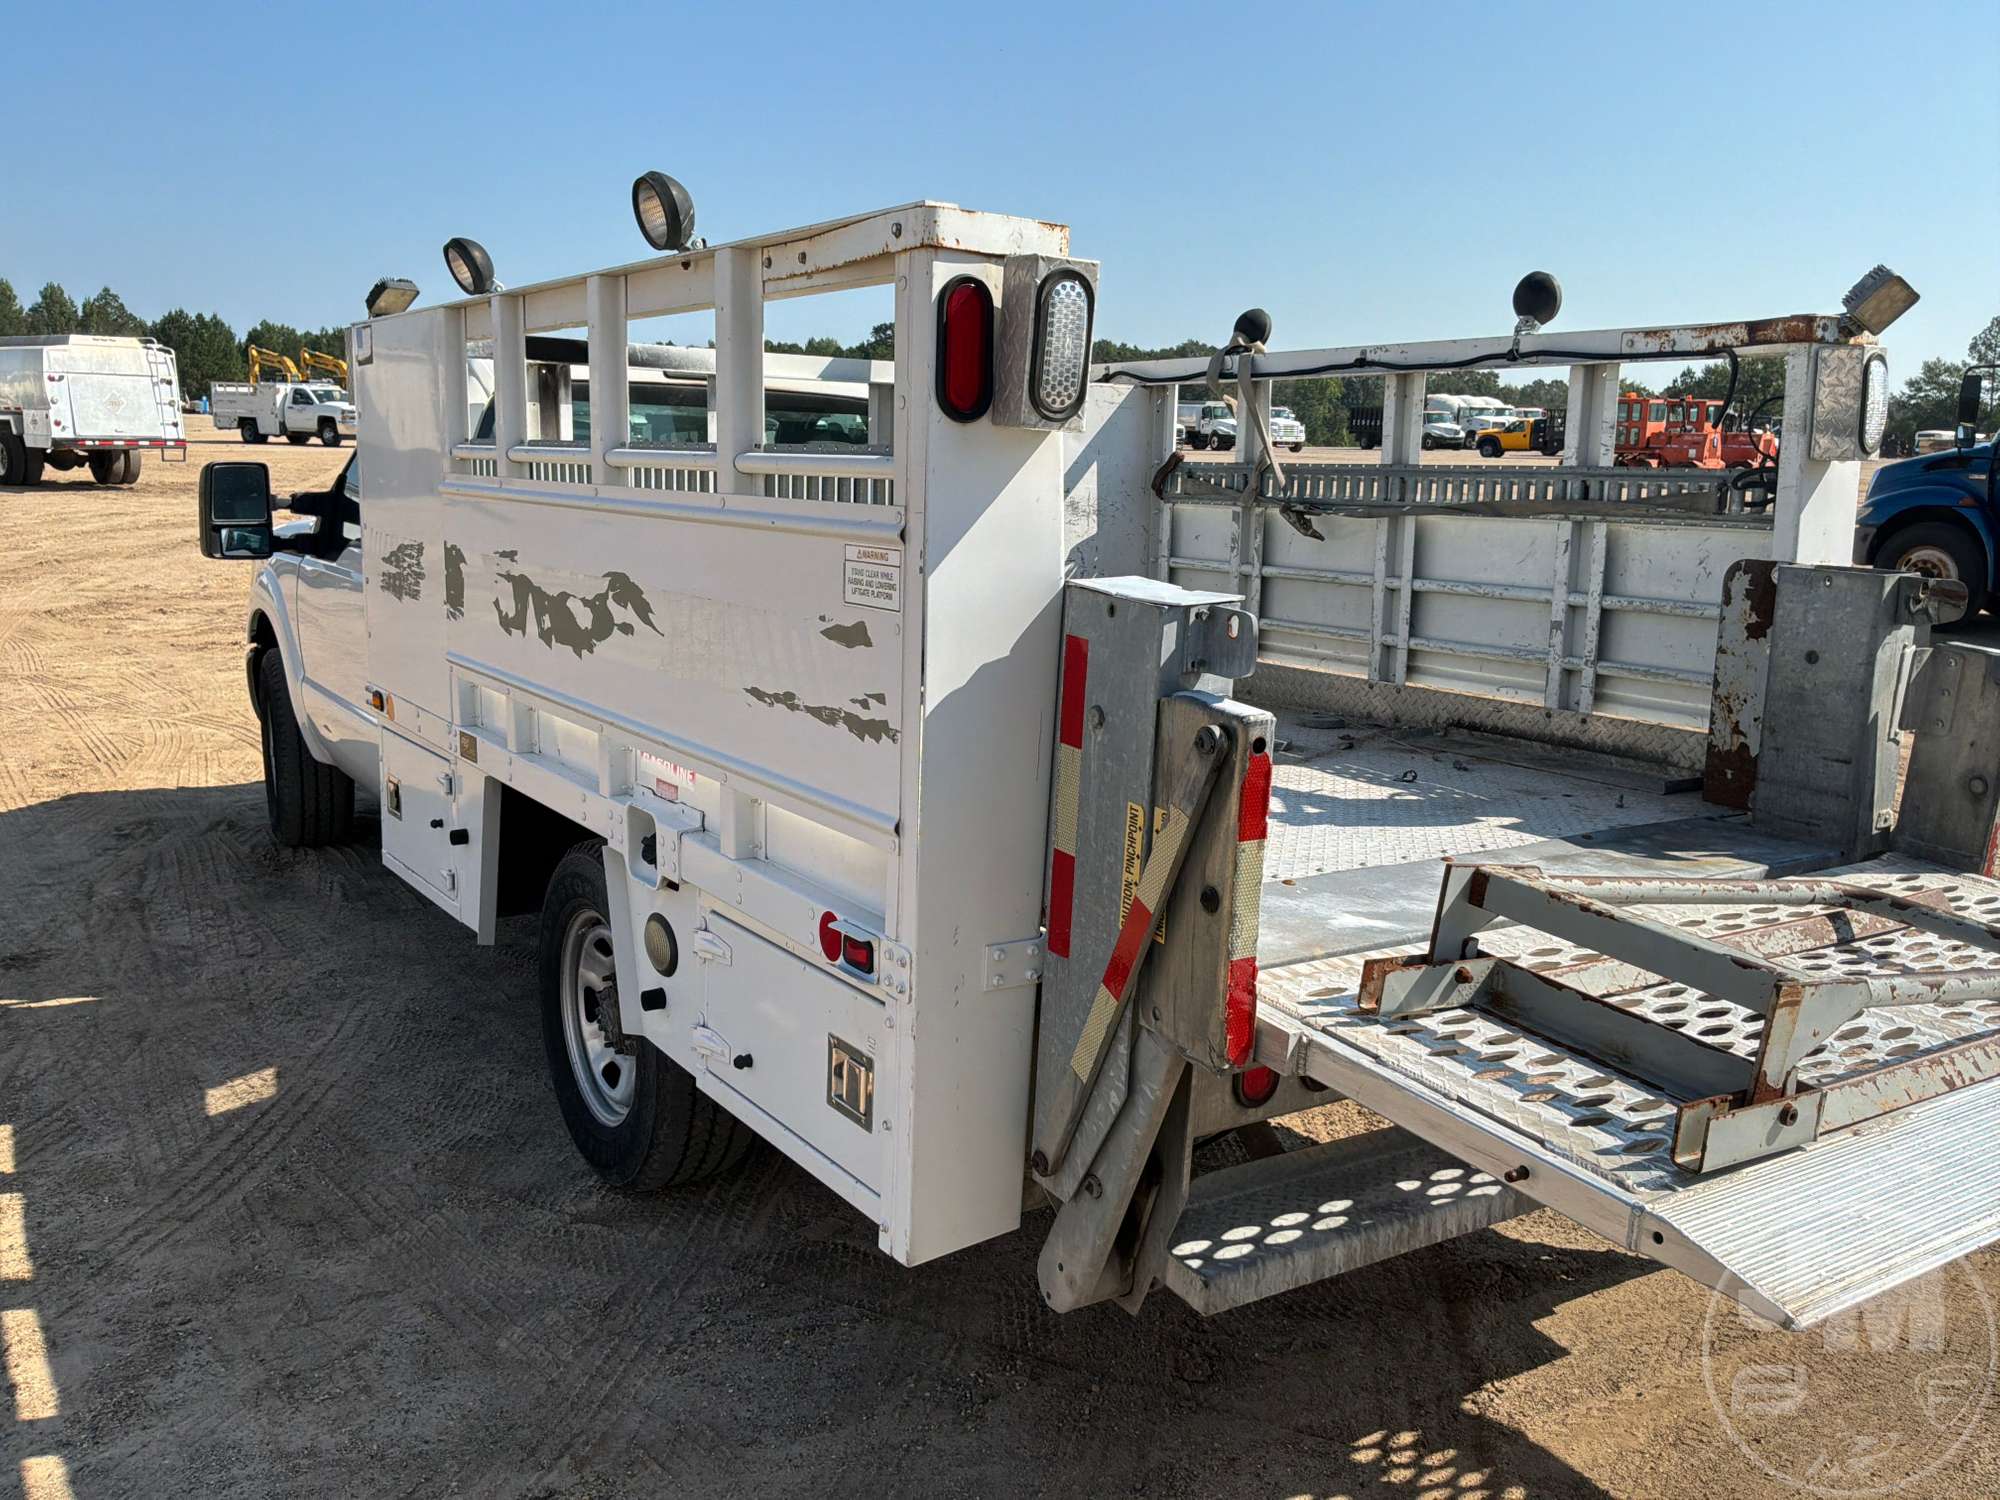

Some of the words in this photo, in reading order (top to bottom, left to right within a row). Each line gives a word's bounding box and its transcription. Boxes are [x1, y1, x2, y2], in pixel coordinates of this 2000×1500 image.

[863, 550, 889, 561] WARNING
[851, 567, 865, 577] STAND
[865, 569, 879, 579] CLEAR
[847, 576, 865, 587] RAISING
[865, 579, 875, 588] AND
[875, 580, 897, 592] LOWERING
[870, 589, 893, 601] PLATFORM
[1125, 805, 1139, 876] PINCHPOINT
